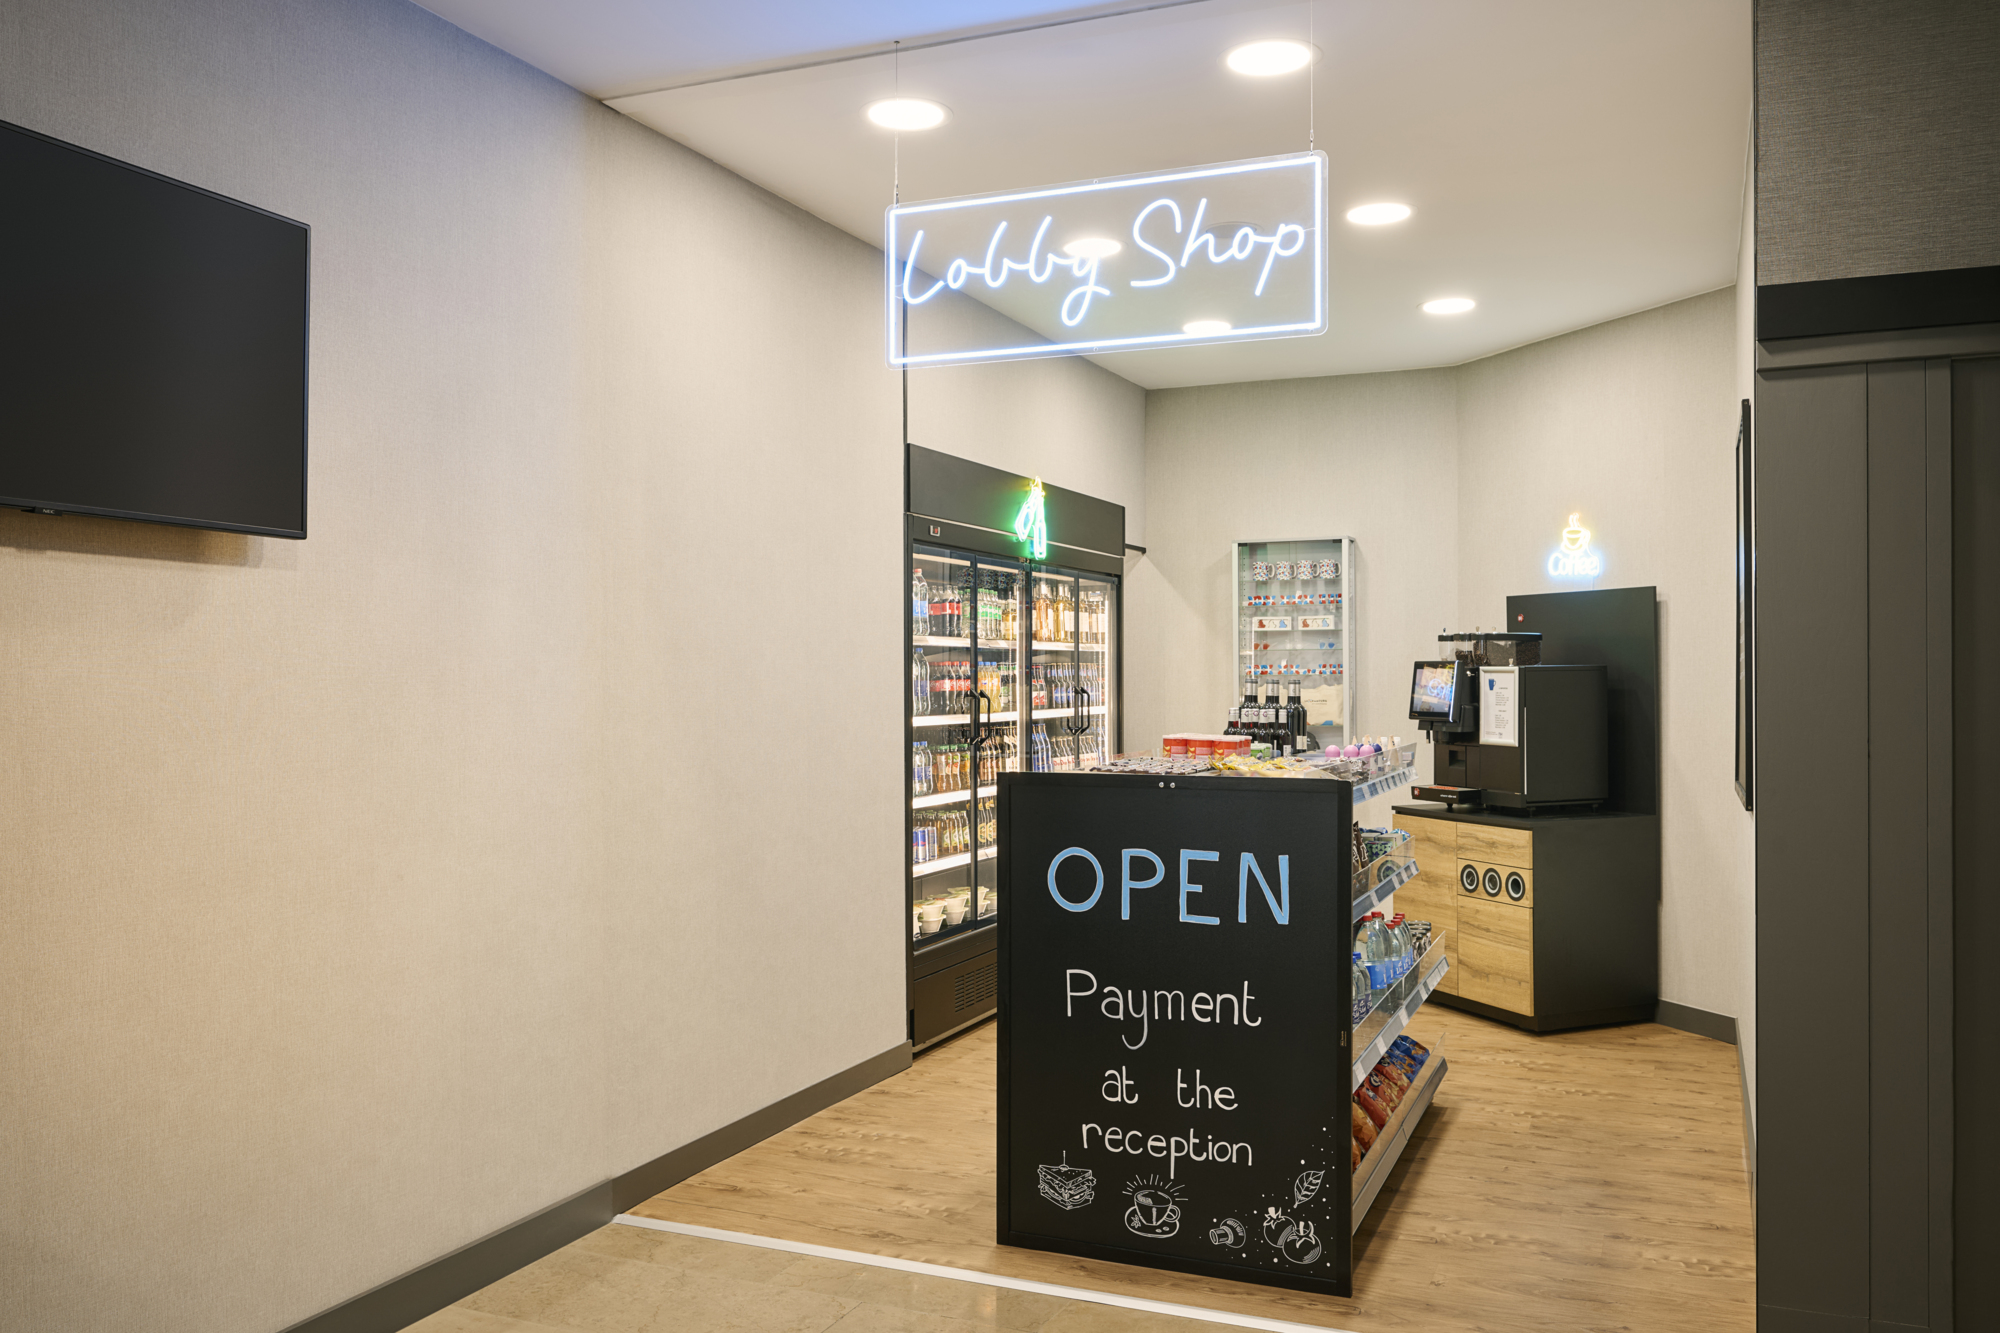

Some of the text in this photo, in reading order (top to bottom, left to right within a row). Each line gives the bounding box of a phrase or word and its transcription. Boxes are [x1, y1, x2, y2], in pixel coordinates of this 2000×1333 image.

[902, 197, 1306, 327] Lobby Shop
[1548, 552, 1598, 576] Coffee
[1047, 846, 1290, 925] OPEN
[1066, 968, 1262, 1050] Payment
[1101, 1065, 1239, 1111] at the
[1081, 1123, 1253, 1180] reception
